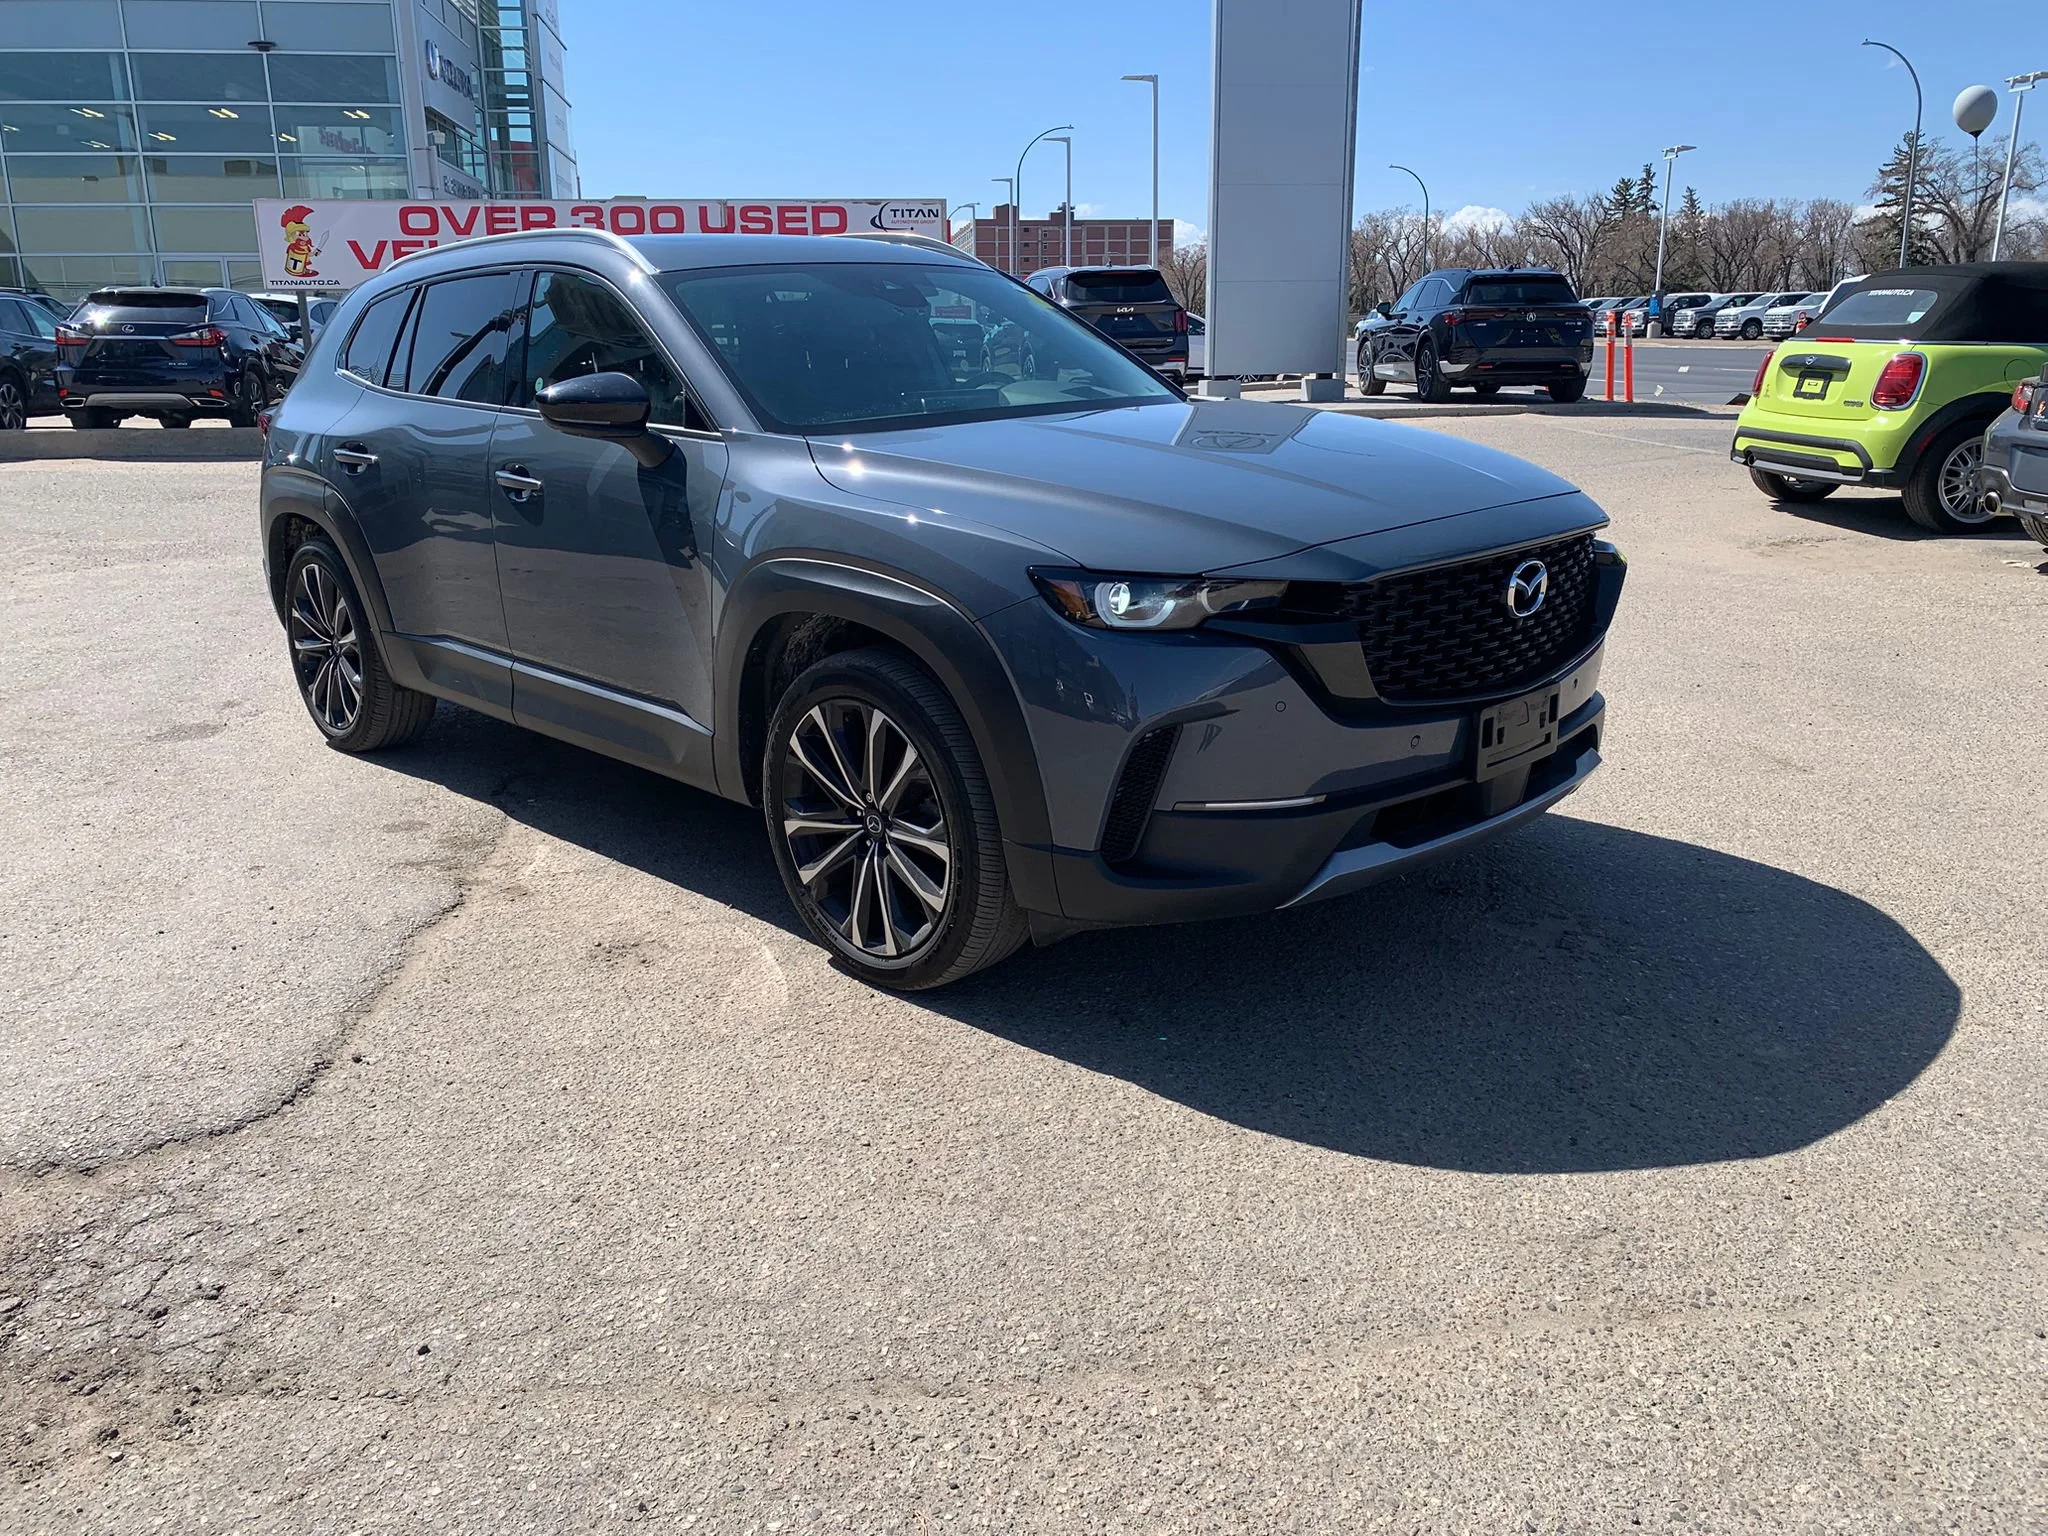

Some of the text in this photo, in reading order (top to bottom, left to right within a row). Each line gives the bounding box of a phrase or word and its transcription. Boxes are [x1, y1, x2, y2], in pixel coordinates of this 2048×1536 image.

[399, 206, 848, 235] OVER 300 USED
[890, 209, 938, 218] TITAN
